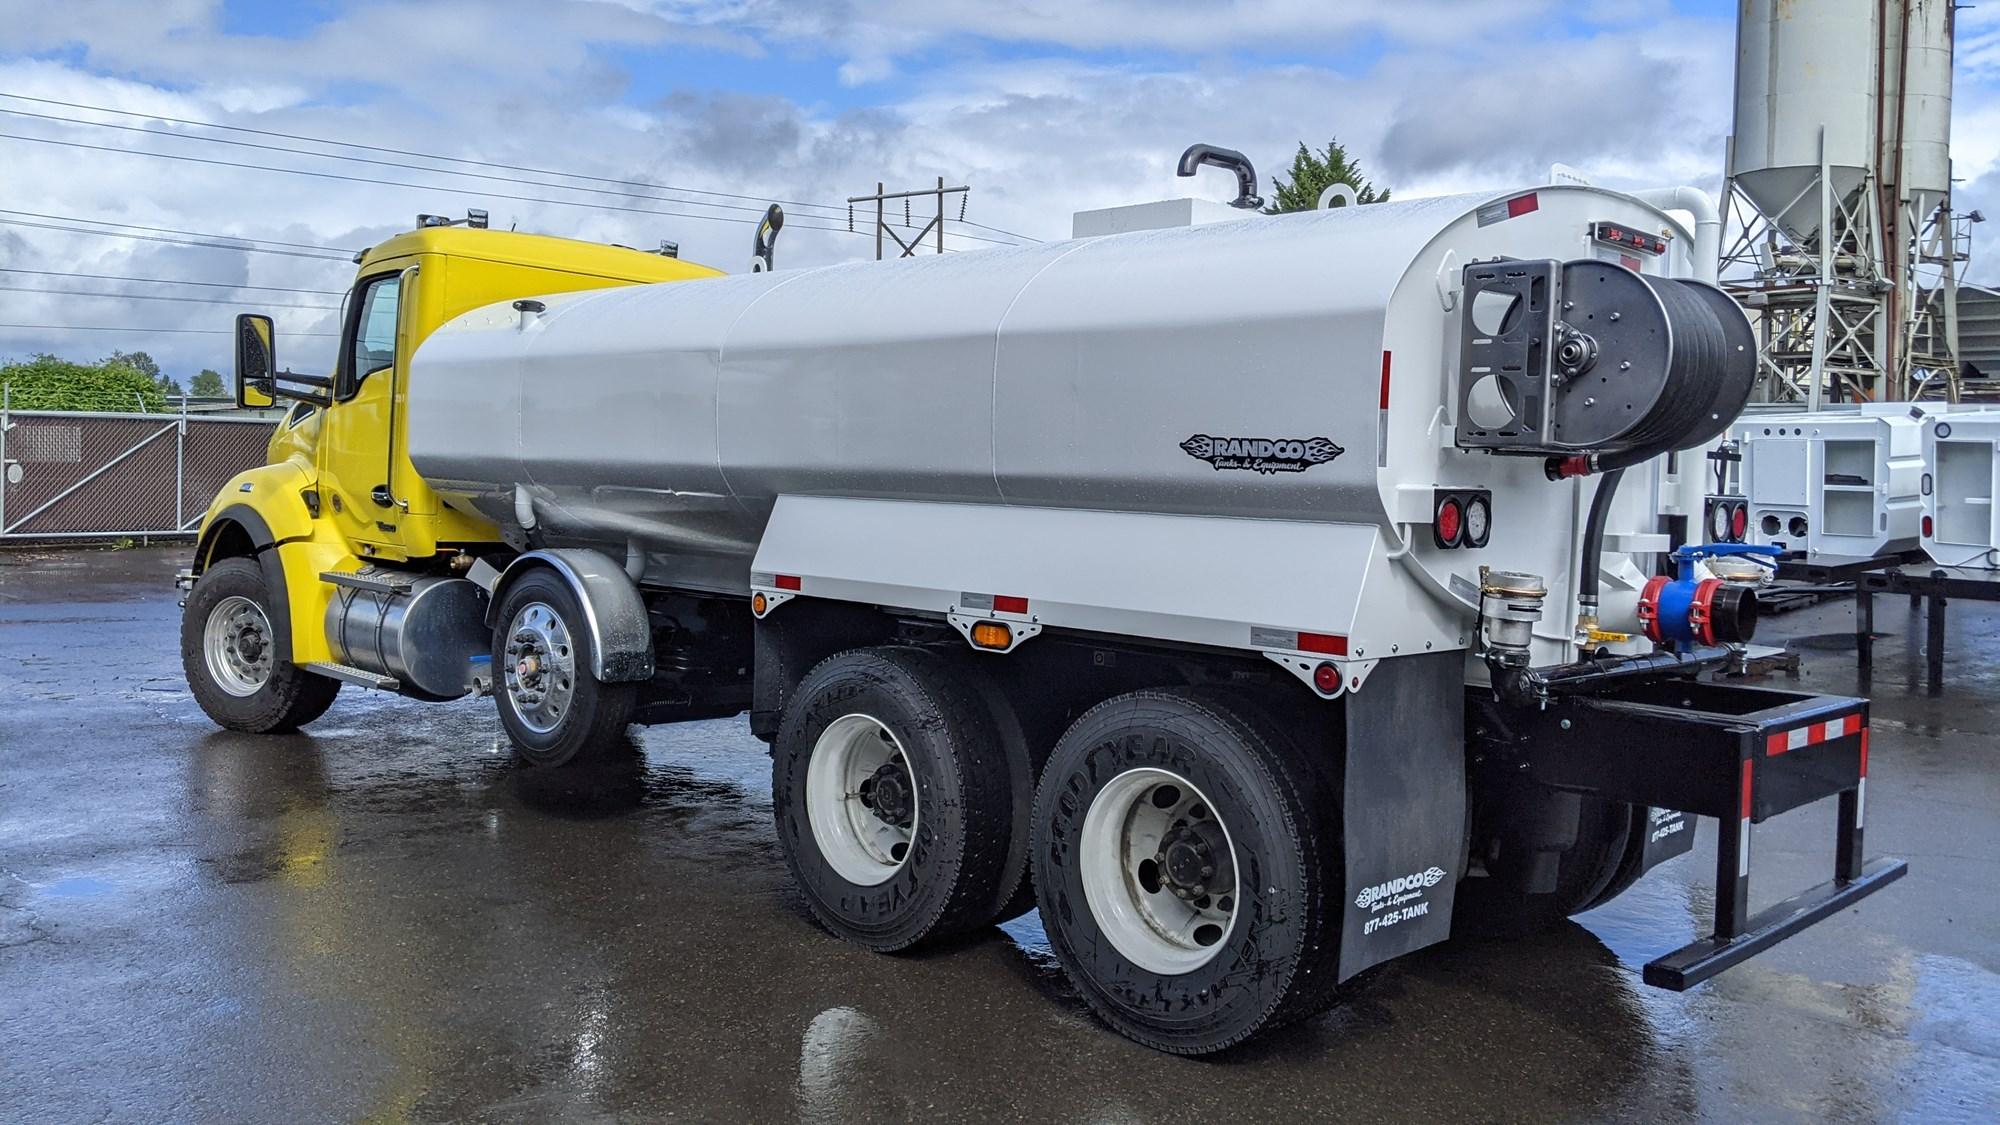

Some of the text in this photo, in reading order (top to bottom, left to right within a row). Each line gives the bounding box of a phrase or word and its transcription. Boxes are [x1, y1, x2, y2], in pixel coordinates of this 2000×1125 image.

[1214, 439, 1304, 459] RANDCO
[1213, 457, 1304, 473] Tanks & Equipment
[1371, 873, 1423, 901] RANDCO
[1364, 901, 1429, 934] 877-425-TANK
